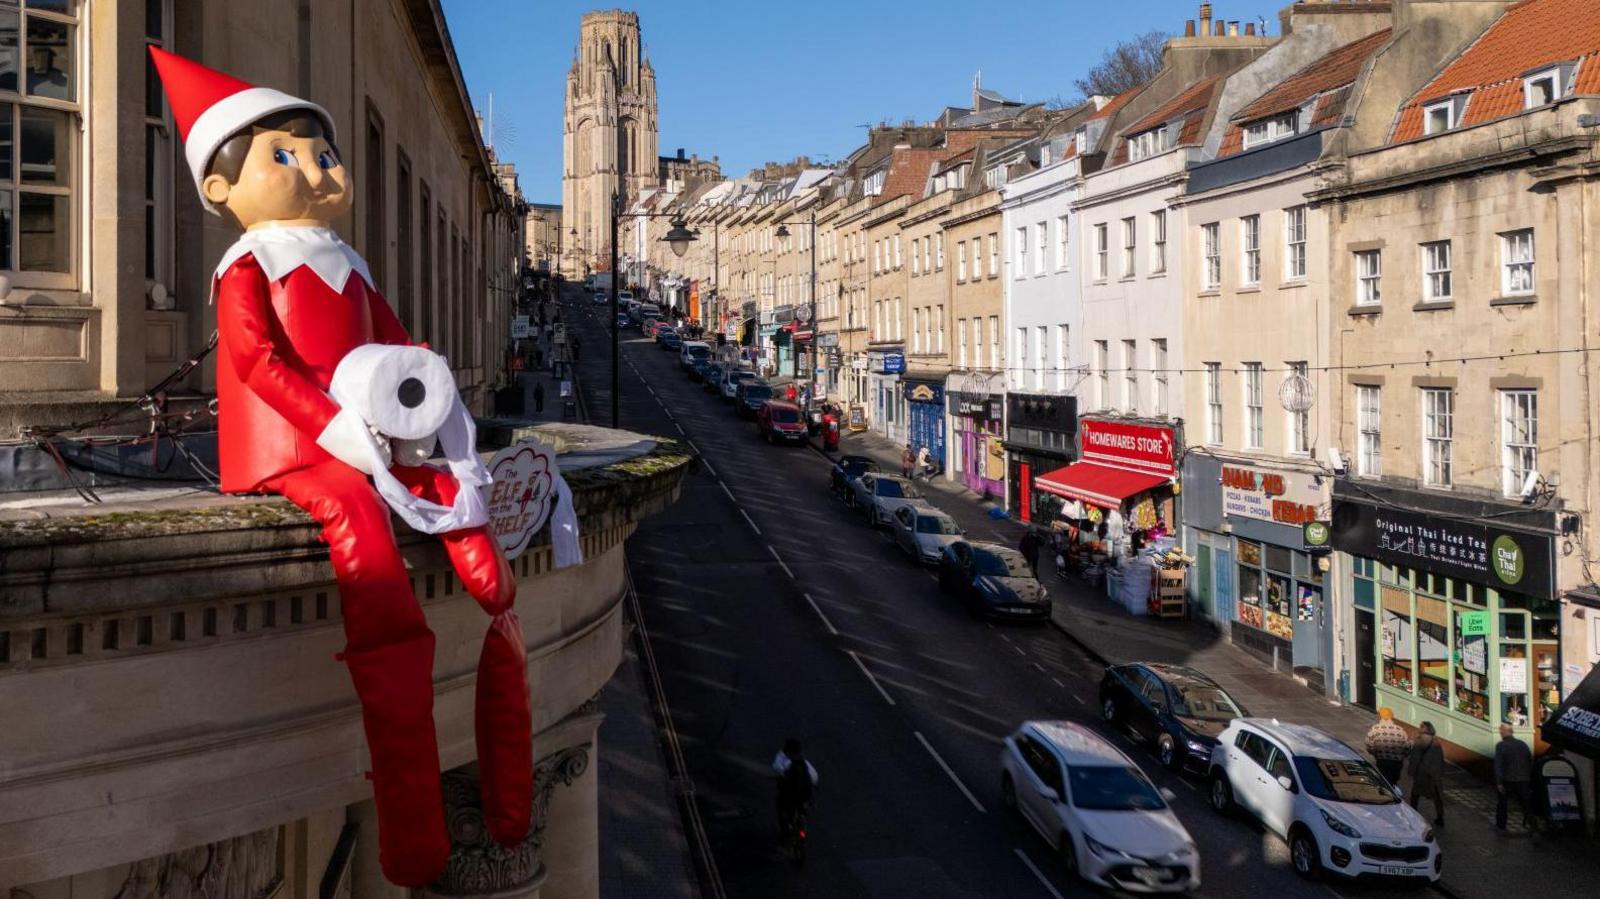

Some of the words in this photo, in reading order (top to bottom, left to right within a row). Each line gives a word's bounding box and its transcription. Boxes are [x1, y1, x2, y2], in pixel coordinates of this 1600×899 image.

[1089, 431, 1136, 450] HOMEWARES
[1137, 437, 1163, 455] STORE
[505, 469, 518, 479] The
[1249, 507, 1271, 517] CHICKEN
[1376, 518, 1413, 535] Original
[1417, 526, 1438, 540] Thai
[1467, 536, 1487, 550] Tea
[1500, 557, 1516, 572] Thai
